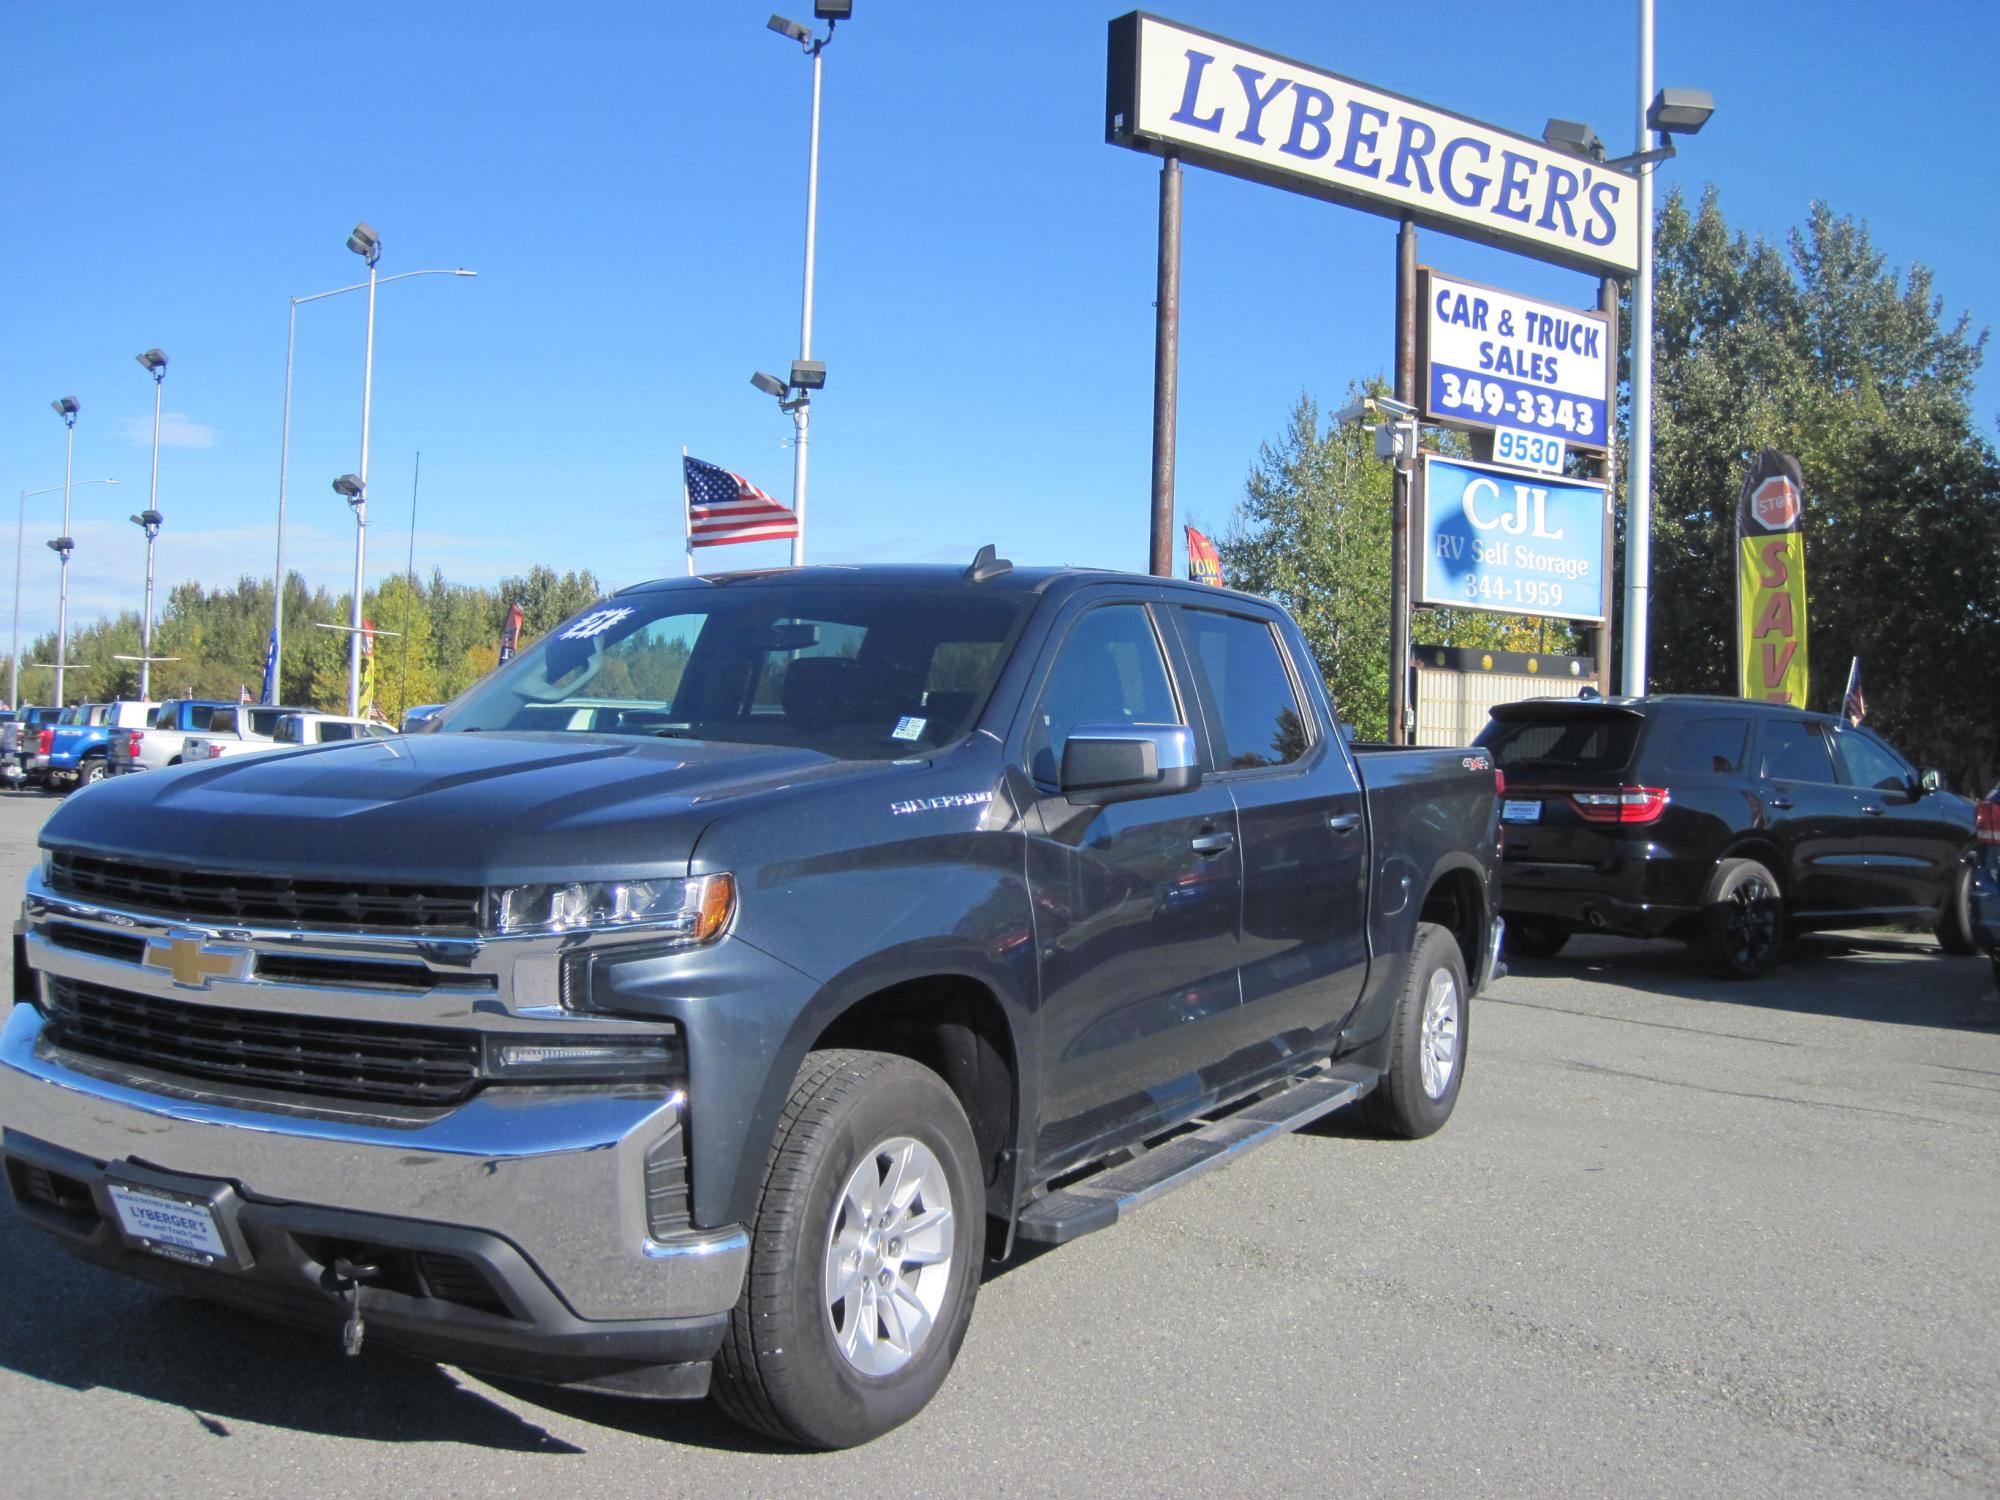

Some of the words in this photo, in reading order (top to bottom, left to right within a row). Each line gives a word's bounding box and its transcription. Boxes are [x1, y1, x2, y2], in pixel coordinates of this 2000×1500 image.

[1170, 49, 1620, 247] LYBERGER'S
[1436, 289, 1489, 332] CAR
[1497, 309, 1515, 338] &
[1525, 310, 1599, 359] TRUCK
[1479, 341, 1558, 384] SALES
[1441, 373, 1594, 436] 349-3343
[1498, 432, 1559, 466] 9530
[1462, 478, 1563, 540] CJL
[1436, 534, 1463, 560] RV
[1471, 540, 1509, 566] Self
[1515, 544, 1589, 580] Storage
[1465, 573, 1563, 607] 344-1959
[1753, 540, 1798, 704] SAV
[130, 1205, 207, 1233] LYBERGER'S
